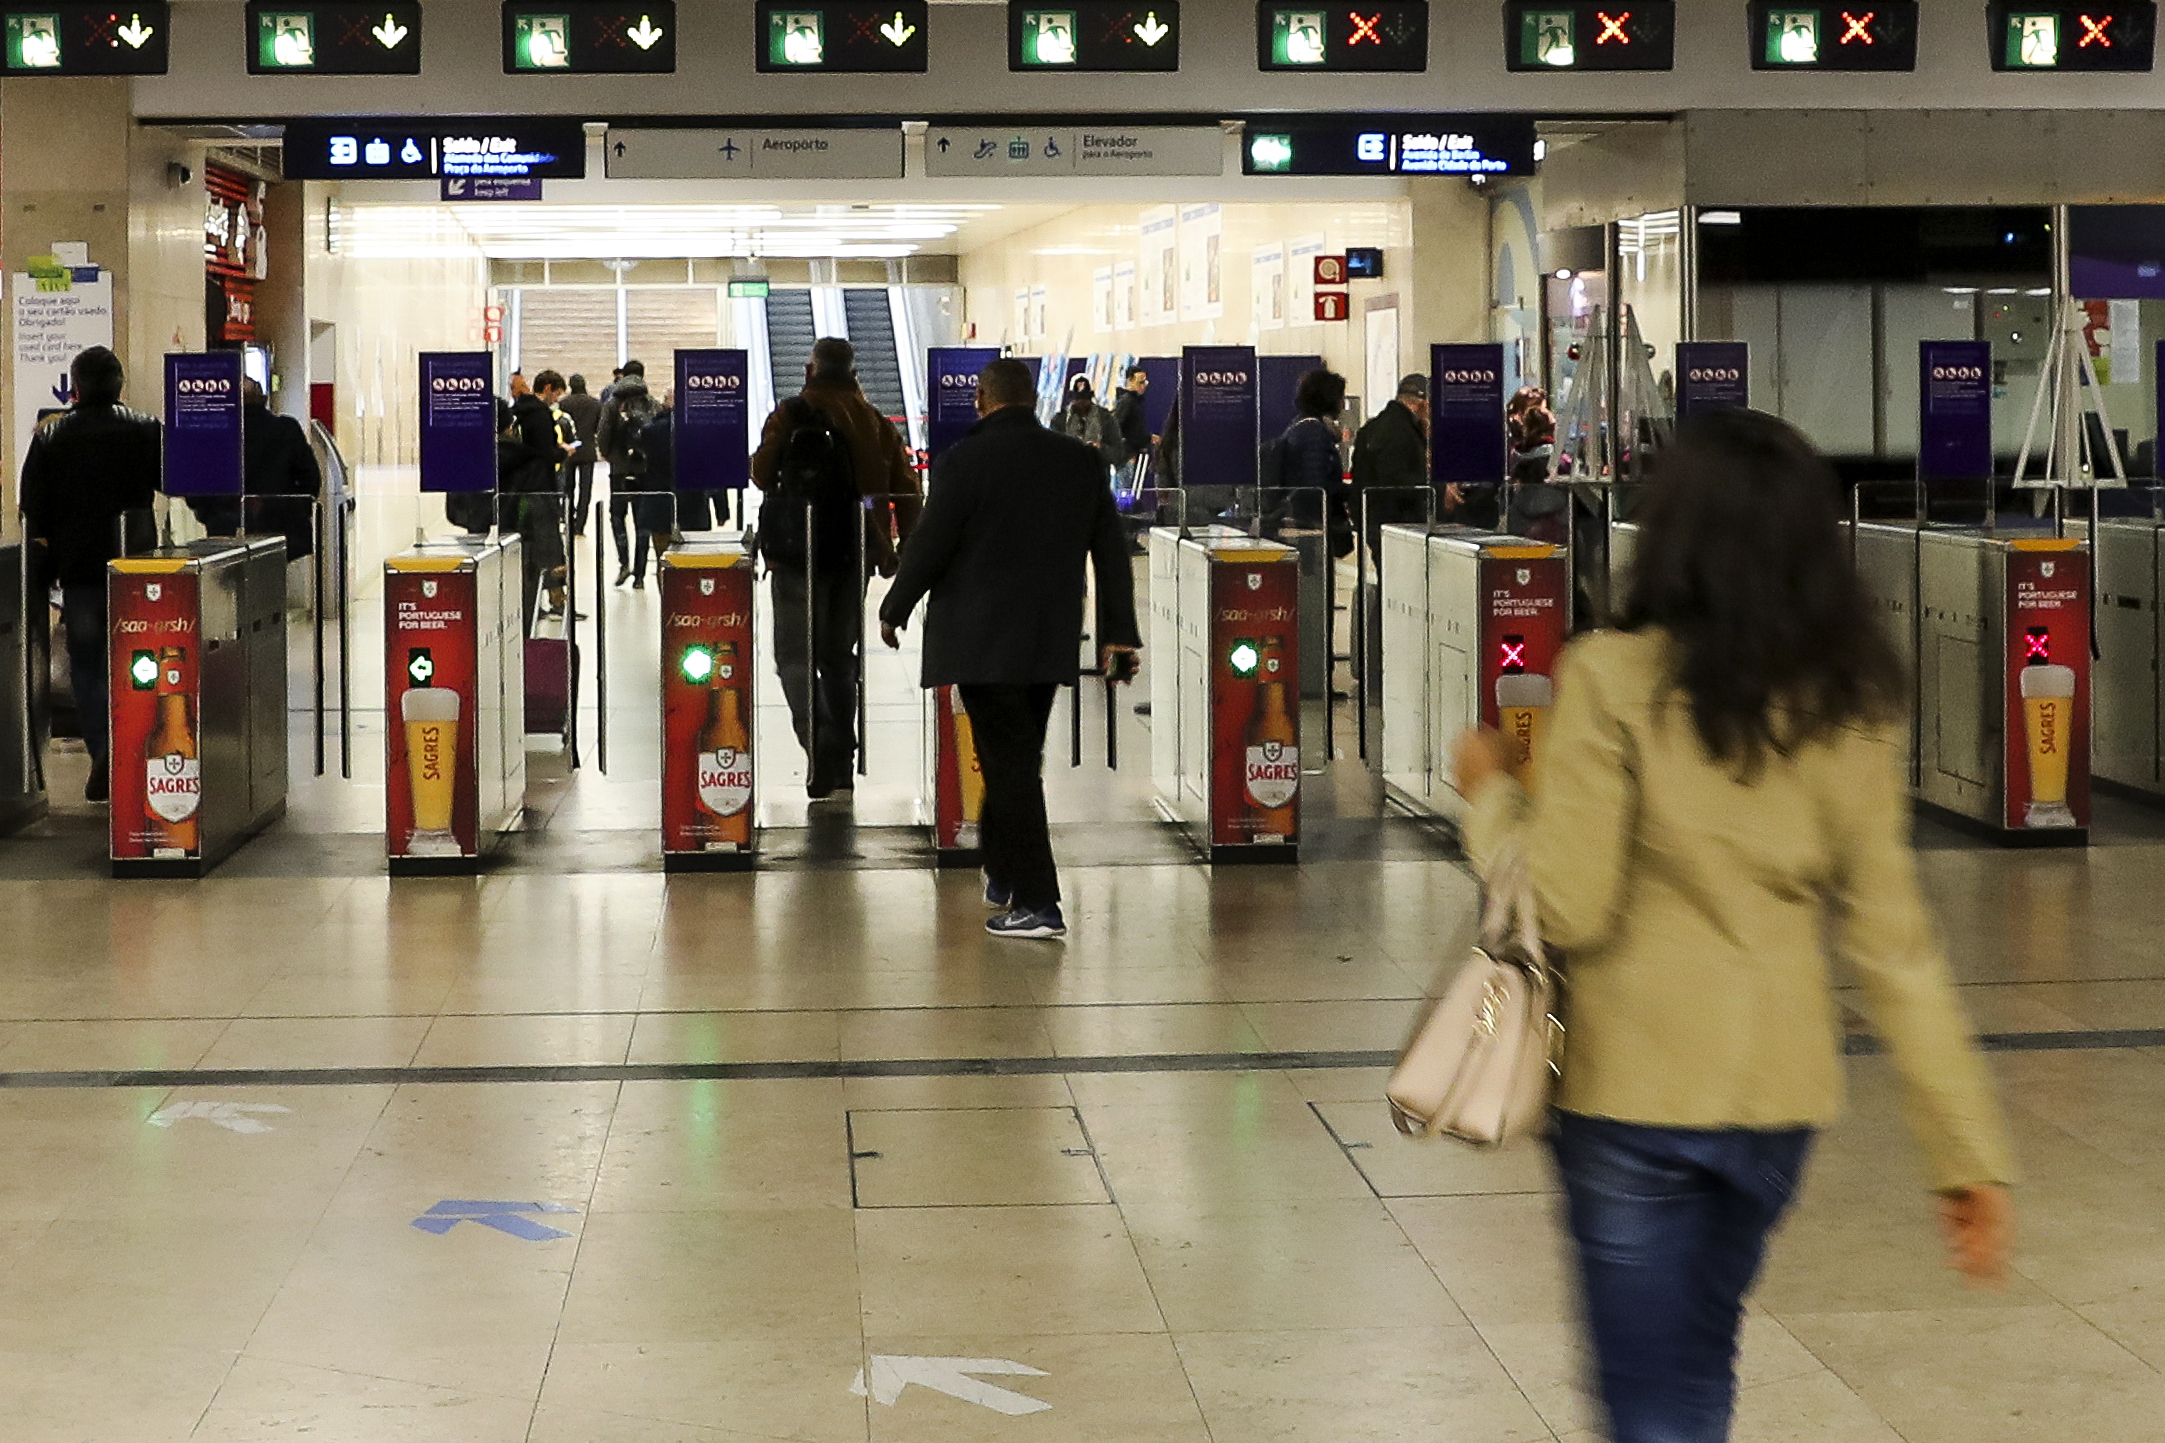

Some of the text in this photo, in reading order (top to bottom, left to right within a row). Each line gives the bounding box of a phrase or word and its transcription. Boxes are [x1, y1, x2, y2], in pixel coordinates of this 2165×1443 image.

[489, 137, 516, 153] Exit
[762, 138, 829, 152] Aeroporto
[1083, 134, 1138, 147] Elevador
[1447, 134, 1473, 150] Exit
[1110, 150, 1153, 160] Aeroporto
[398, 602, 417, 611] IT'S
[1493, 598, 1554, 607] PORTUGUESE
[398, 611, 462, 620] PORTUGUESE
[398, 621, 419, 630] FOR
[2040, 702, 2056, 755] SAGRES
[422, 726, 440, 781] SAGRES
[1248, 762, 1299, 782] SAGRES
[149, 777, 200, 795] SAGRES
[701, 771, 752, 789] SAGRES
